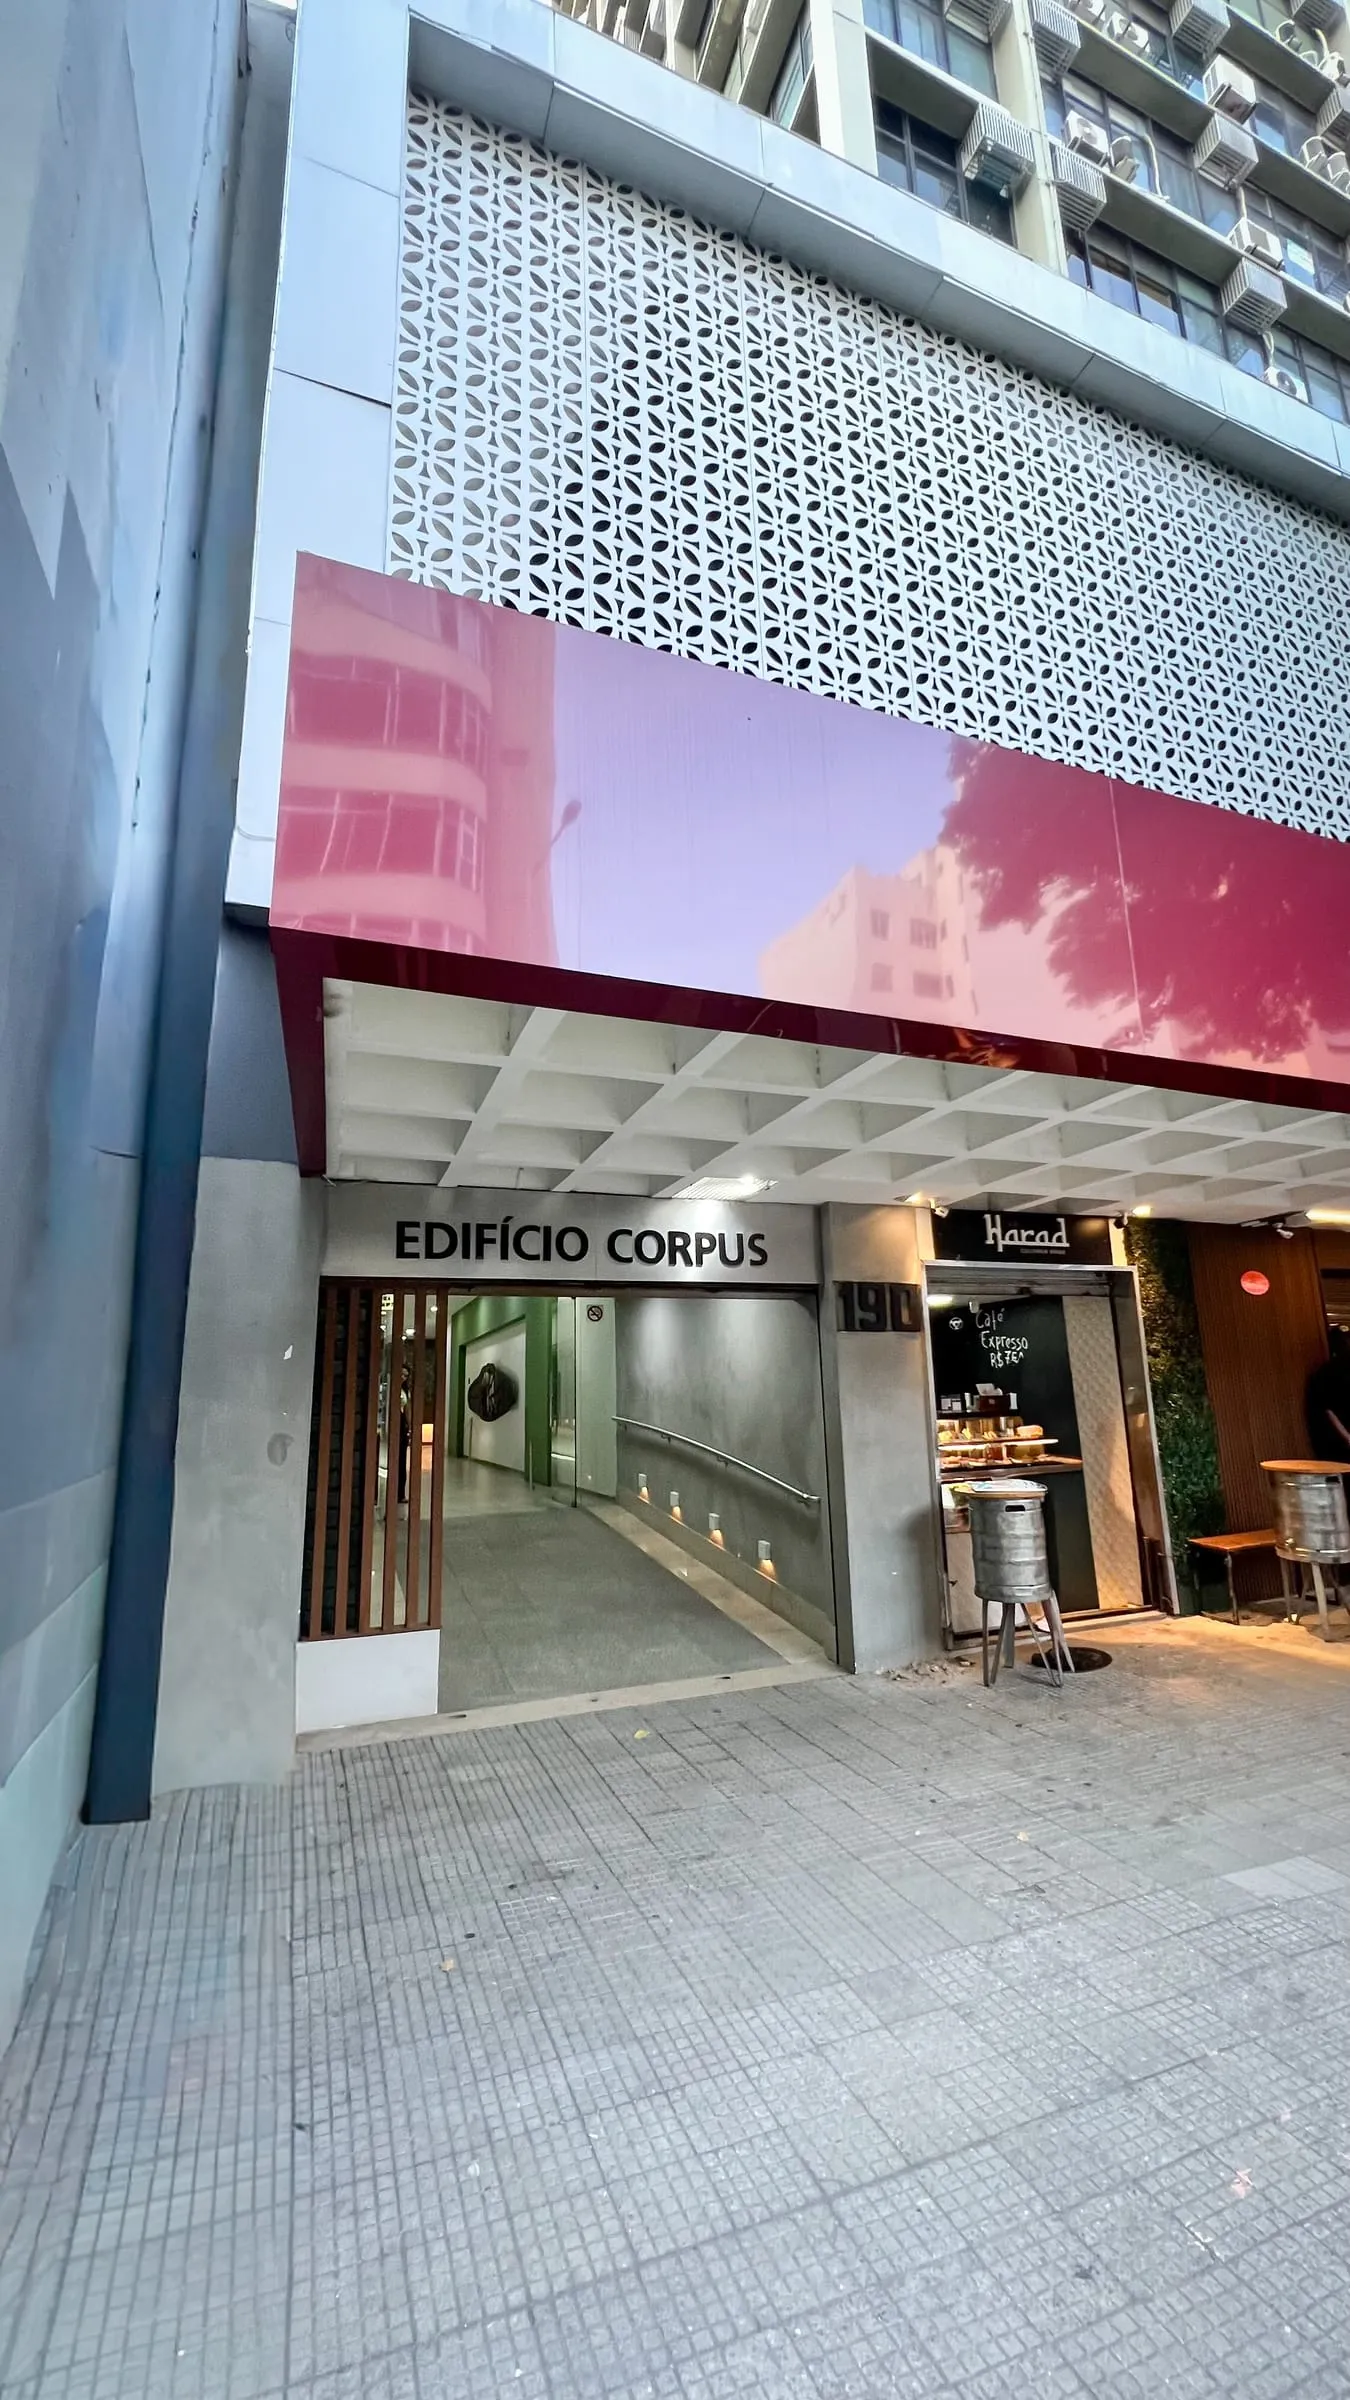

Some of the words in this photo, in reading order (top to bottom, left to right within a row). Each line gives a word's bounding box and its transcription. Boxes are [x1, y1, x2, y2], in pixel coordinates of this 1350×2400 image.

[395, 1216, 589, 1262] EDIFÍCIO
[607, 1229, 769, 1268] CORPUS
[983, 1214, 1070, 1252] Harad
[838, 1283, 922, 1332] 190
[976, 1308, 1005, 1330] Café
[981, 1330, 1028, 1351] Expresso
